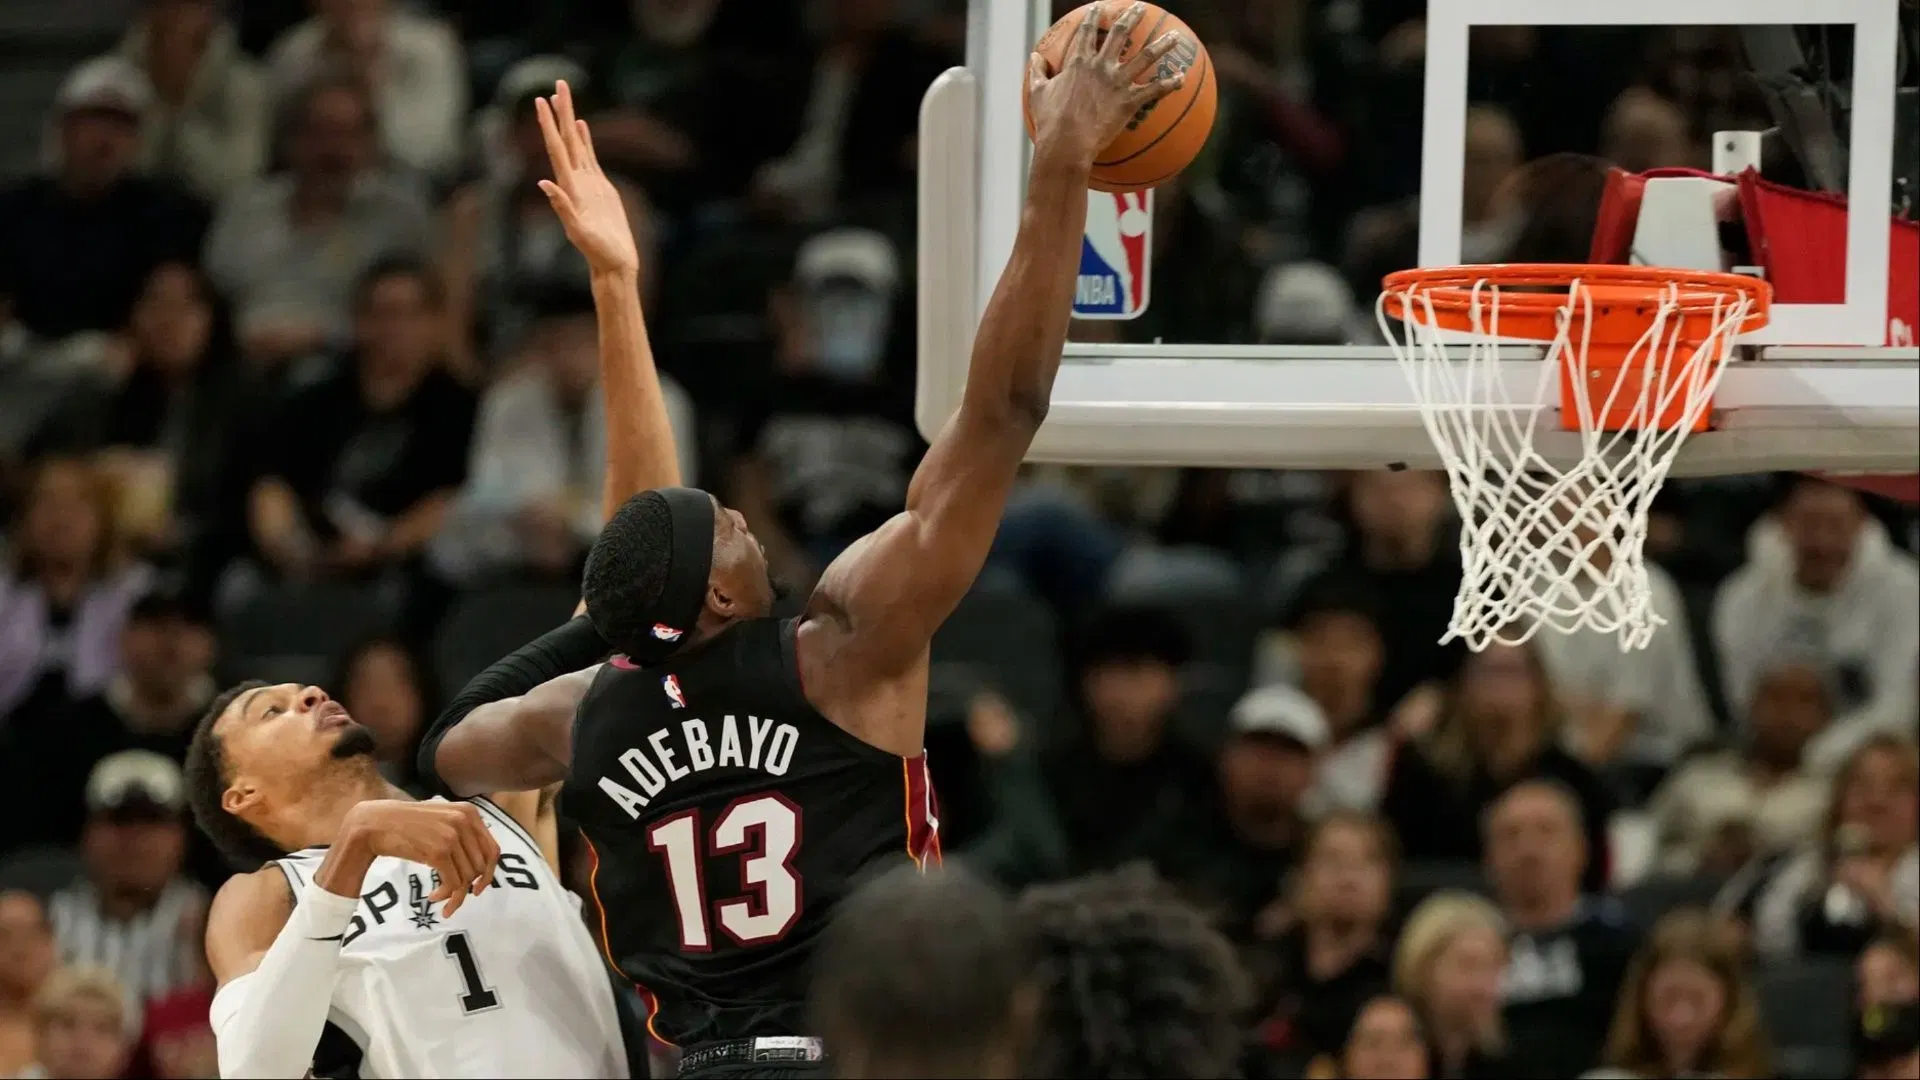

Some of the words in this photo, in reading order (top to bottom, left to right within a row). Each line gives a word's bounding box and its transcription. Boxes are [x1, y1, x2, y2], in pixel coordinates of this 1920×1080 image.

[1075, 274, 1116, 305] NBA
[598, 715, 799, 819] ADEBAYO
[647, 791, 803, 952] 13
[442, 930, 501, 1014] 1
